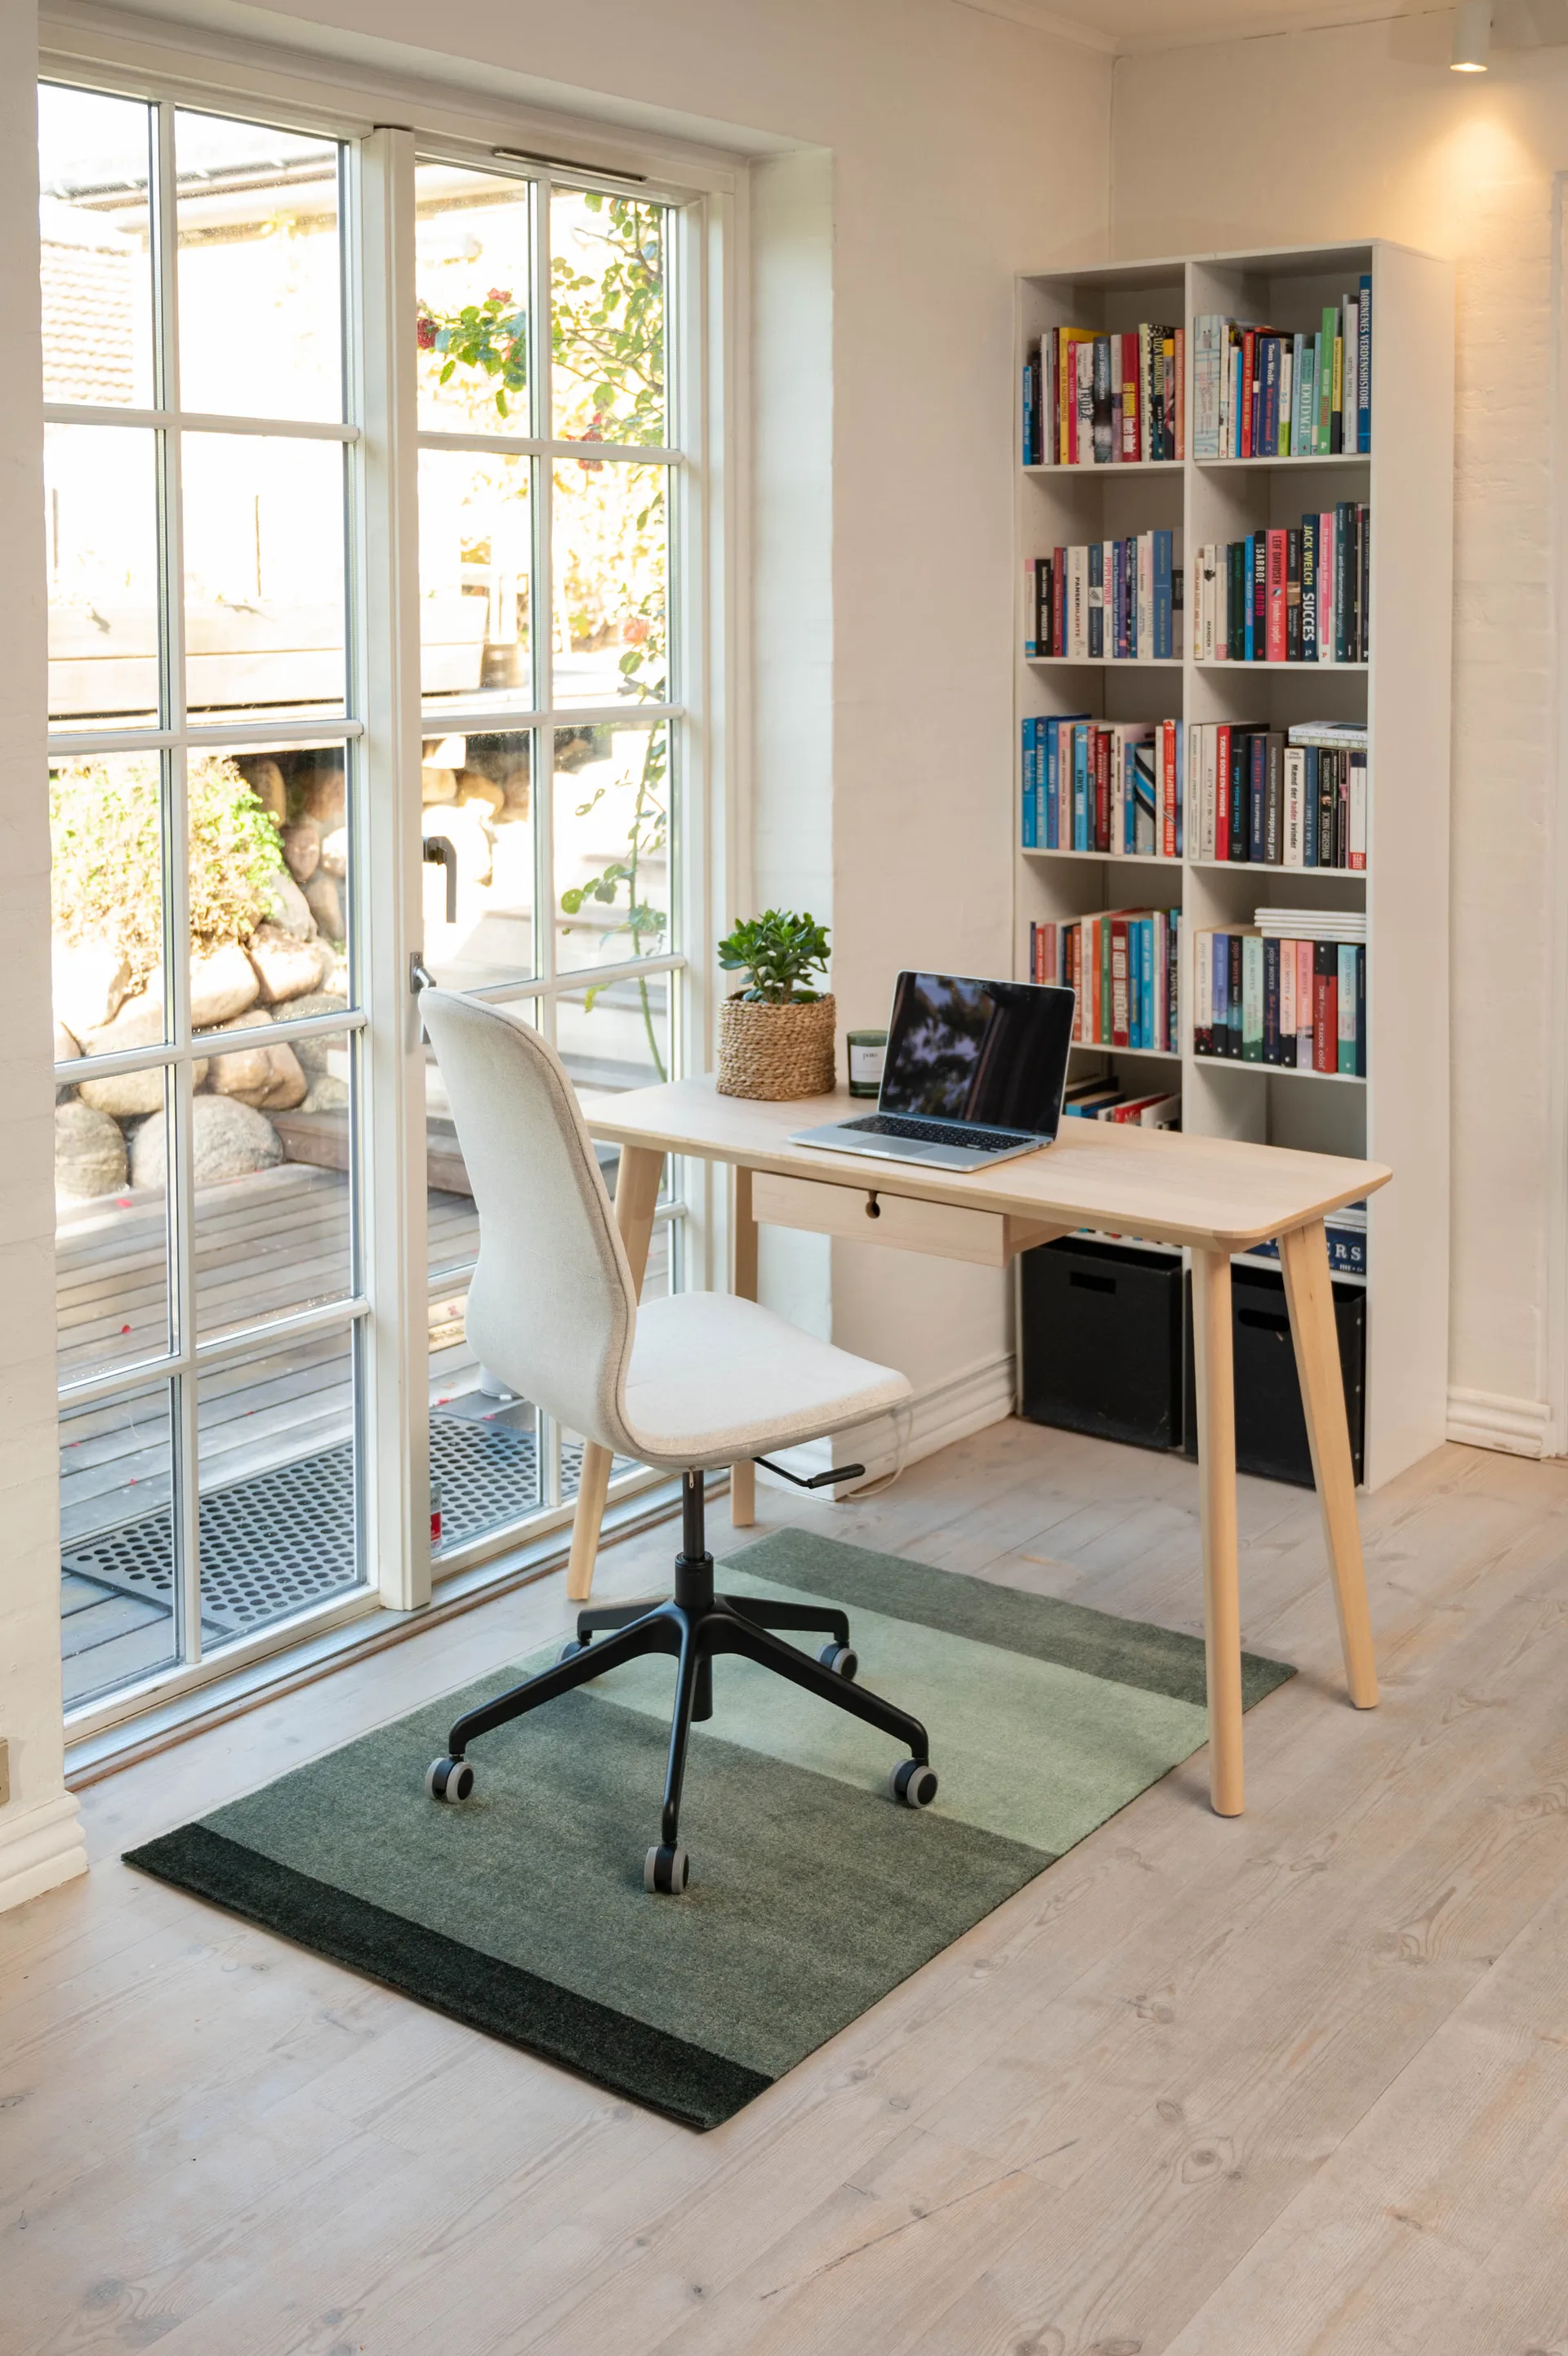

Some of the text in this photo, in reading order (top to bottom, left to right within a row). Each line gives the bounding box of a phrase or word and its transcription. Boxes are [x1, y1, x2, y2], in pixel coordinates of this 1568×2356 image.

[1098, 344, 1107, 360] jussi
[1359, 289, 1370, 409] BØRNENES VERDENSHISTORIE
[1153, 338, 1164, 395] LIZA MARKLUND
[1245, 369, 1250, 377] AT
[1080, 387, 1092, 421] TROFÆ
[1300, 383, 1312, 403] 100
[1299, 405, 1311, 438] DAGE
[1272, 536, 1281, 550] LEIF
[1272, 552, 1281, 585] DAVIDSEN
[1255, 549, 1265, 616] SABROE LIBIDO
[1303, 525, 1314, 641] JACK WELCH SUCCES
[1272, 600, 1281, 621] Fjenden
[1272, 625, 1281, 644] spejlet
[1076, 770, 1085, 793] VANEN
[1165, 764, 1174, 804] DISRUPTION
[1219, 777, 1226, 787] EN
[1267, 946, 1275, 964] JOJO
[1317, 1050, 1325, 1069] JOJO
